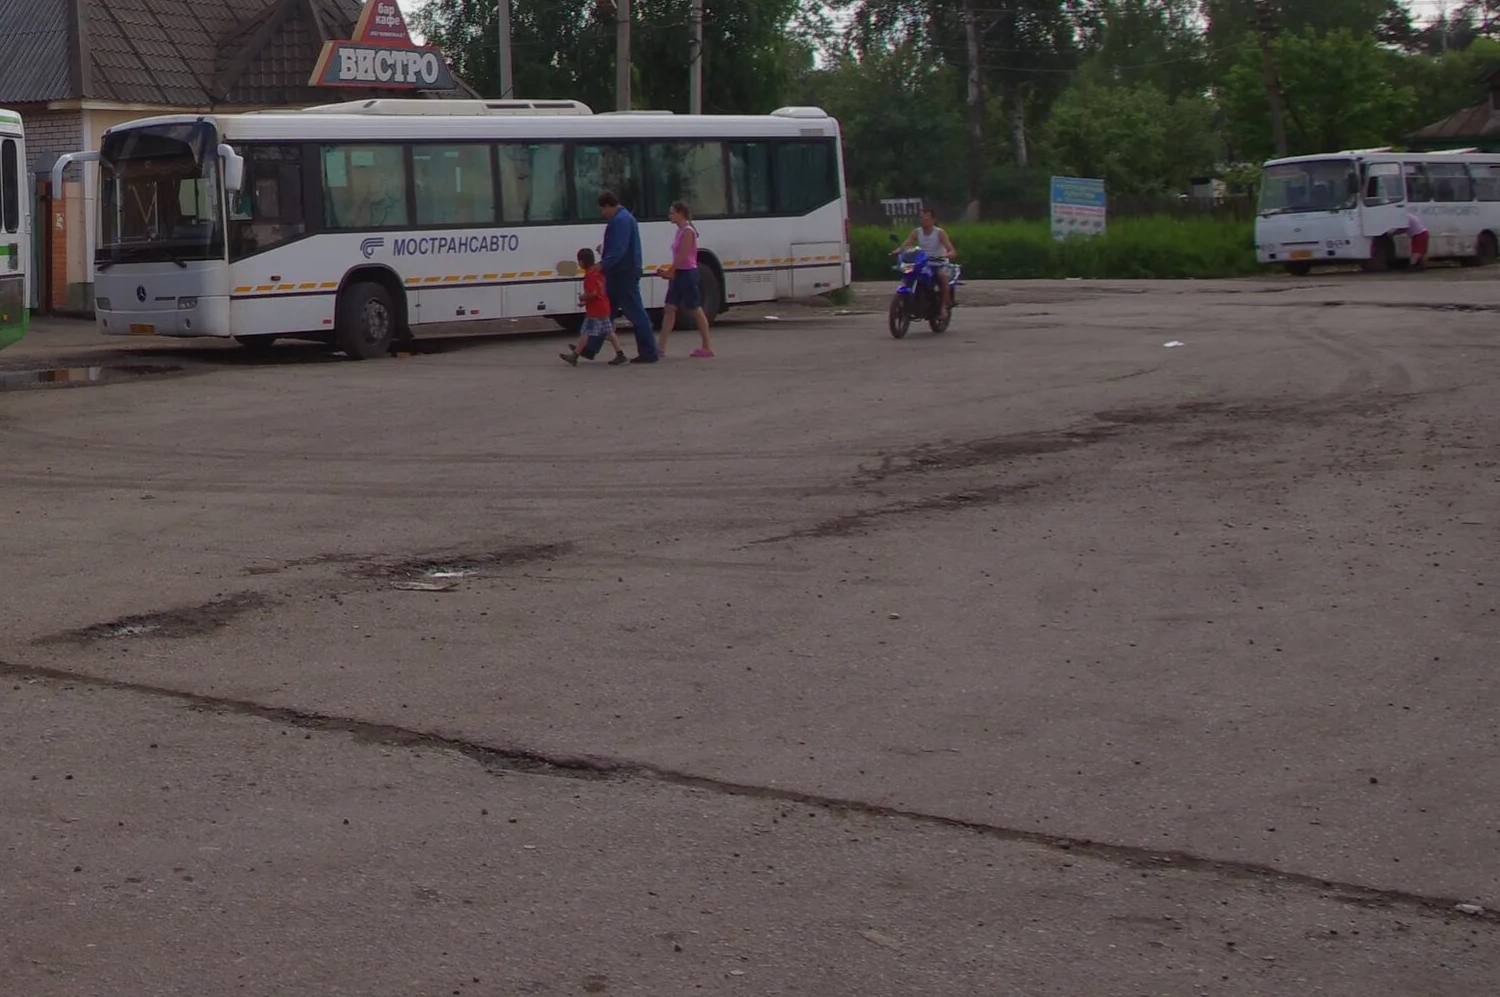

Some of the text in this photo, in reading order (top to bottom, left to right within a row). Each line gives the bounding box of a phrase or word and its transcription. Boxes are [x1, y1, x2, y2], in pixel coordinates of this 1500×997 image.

[378, 2, 395, 16] бар
[375, 16, 401, 28] кафе
[338, 47, 439, 84] БИСТРО
[393, 234, 519, 257] МОСТРАНСАВТО
